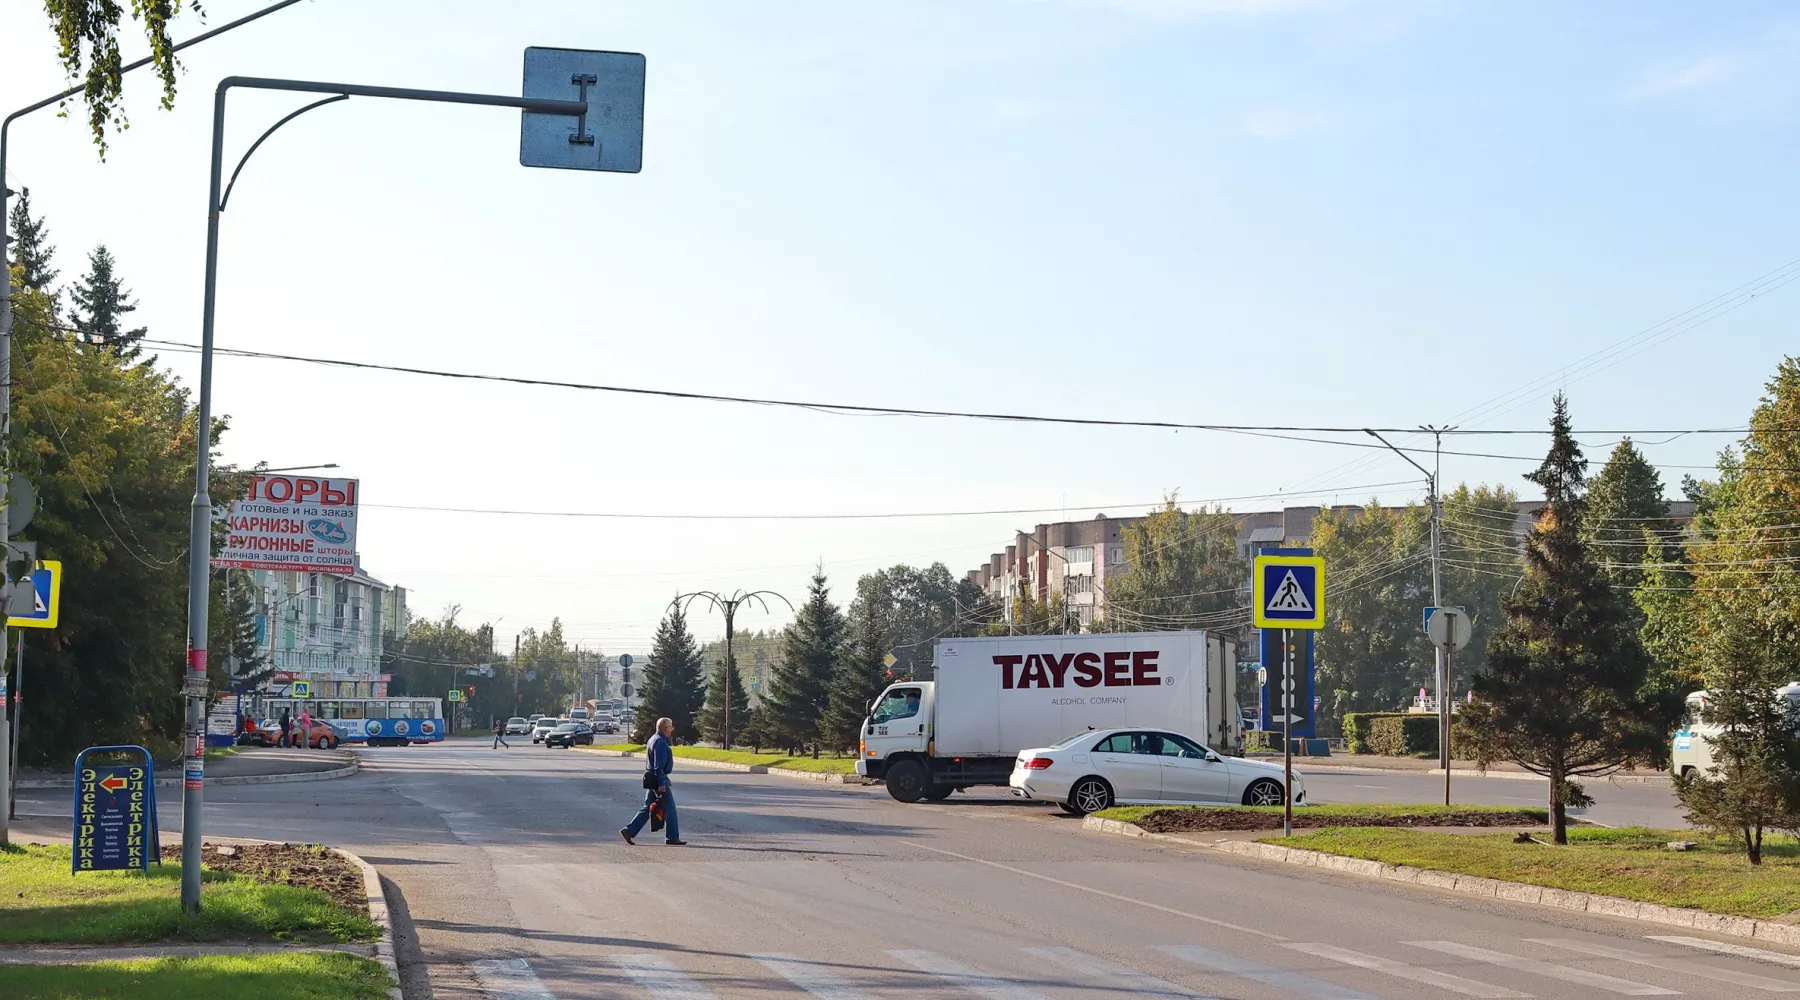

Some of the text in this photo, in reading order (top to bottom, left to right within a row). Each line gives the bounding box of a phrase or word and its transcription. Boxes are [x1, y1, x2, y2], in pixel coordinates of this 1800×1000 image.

[248, 476, 355, 507] ТОРЫ
[241, 503, 354, 518] готовые и на заказ
[230, 516, 304, 534] КАРНИЗЫ
[229, 535, 353, 556] РУЛОННЫЕ шторы
[219, 551, 353, 566] тличная защита от солнца
[991, 650, 1162, 690] TAYSEE
[1051, 696, 1127, 706] ALCOHOL COMPANY
[78, 768, 97, 869] Электрика
[126, 767, 144, 868] Электрика
